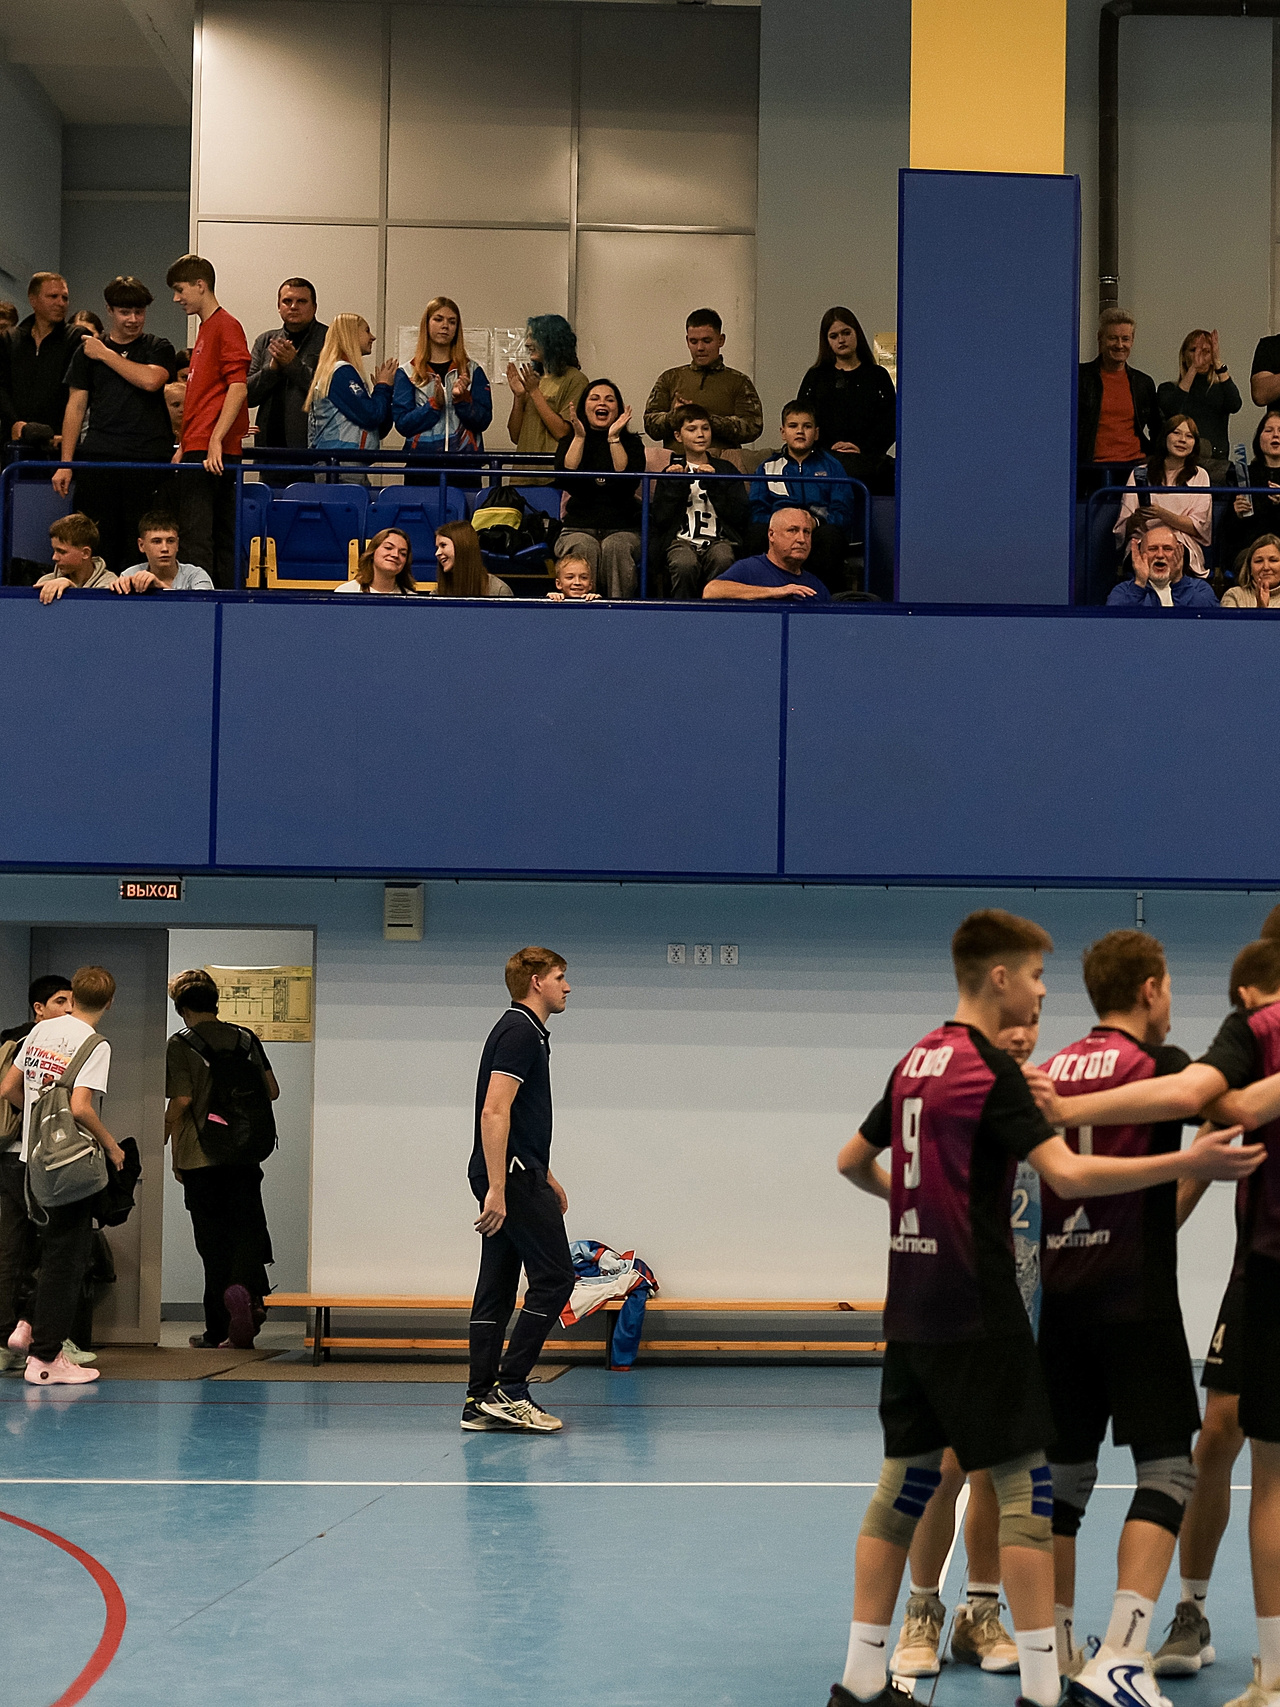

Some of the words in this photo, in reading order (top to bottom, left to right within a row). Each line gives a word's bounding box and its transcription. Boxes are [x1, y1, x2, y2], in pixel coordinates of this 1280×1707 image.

[126, 884, 177, 899] ВЫХОД
[1048, 1049, 1120, 1081] ПСКОВ
[902, 1097, 923, 1189] 9
[1212, 1323, 1226, 1354] 4
